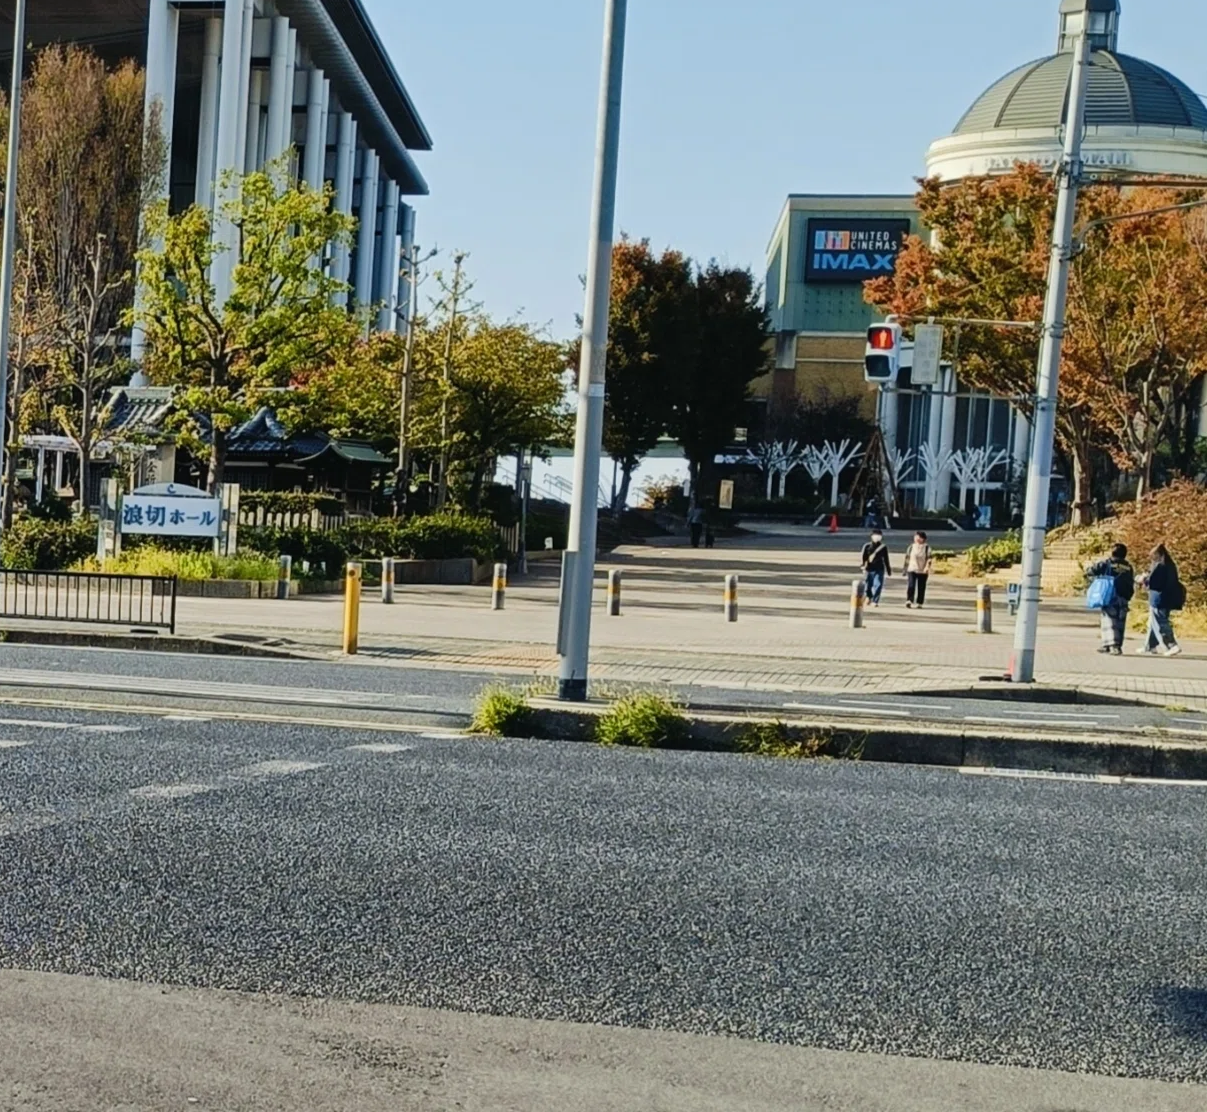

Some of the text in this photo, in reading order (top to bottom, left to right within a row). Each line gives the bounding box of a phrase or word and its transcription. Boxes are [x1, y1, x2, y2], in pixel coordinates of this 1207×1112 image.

[851, 231, 890, 241] UNITED
[850, 240, 898, 251] CINEMAS
[814, 253, 893, 270] IMAX
[123, 503, 217, 527] 浪切ホール
